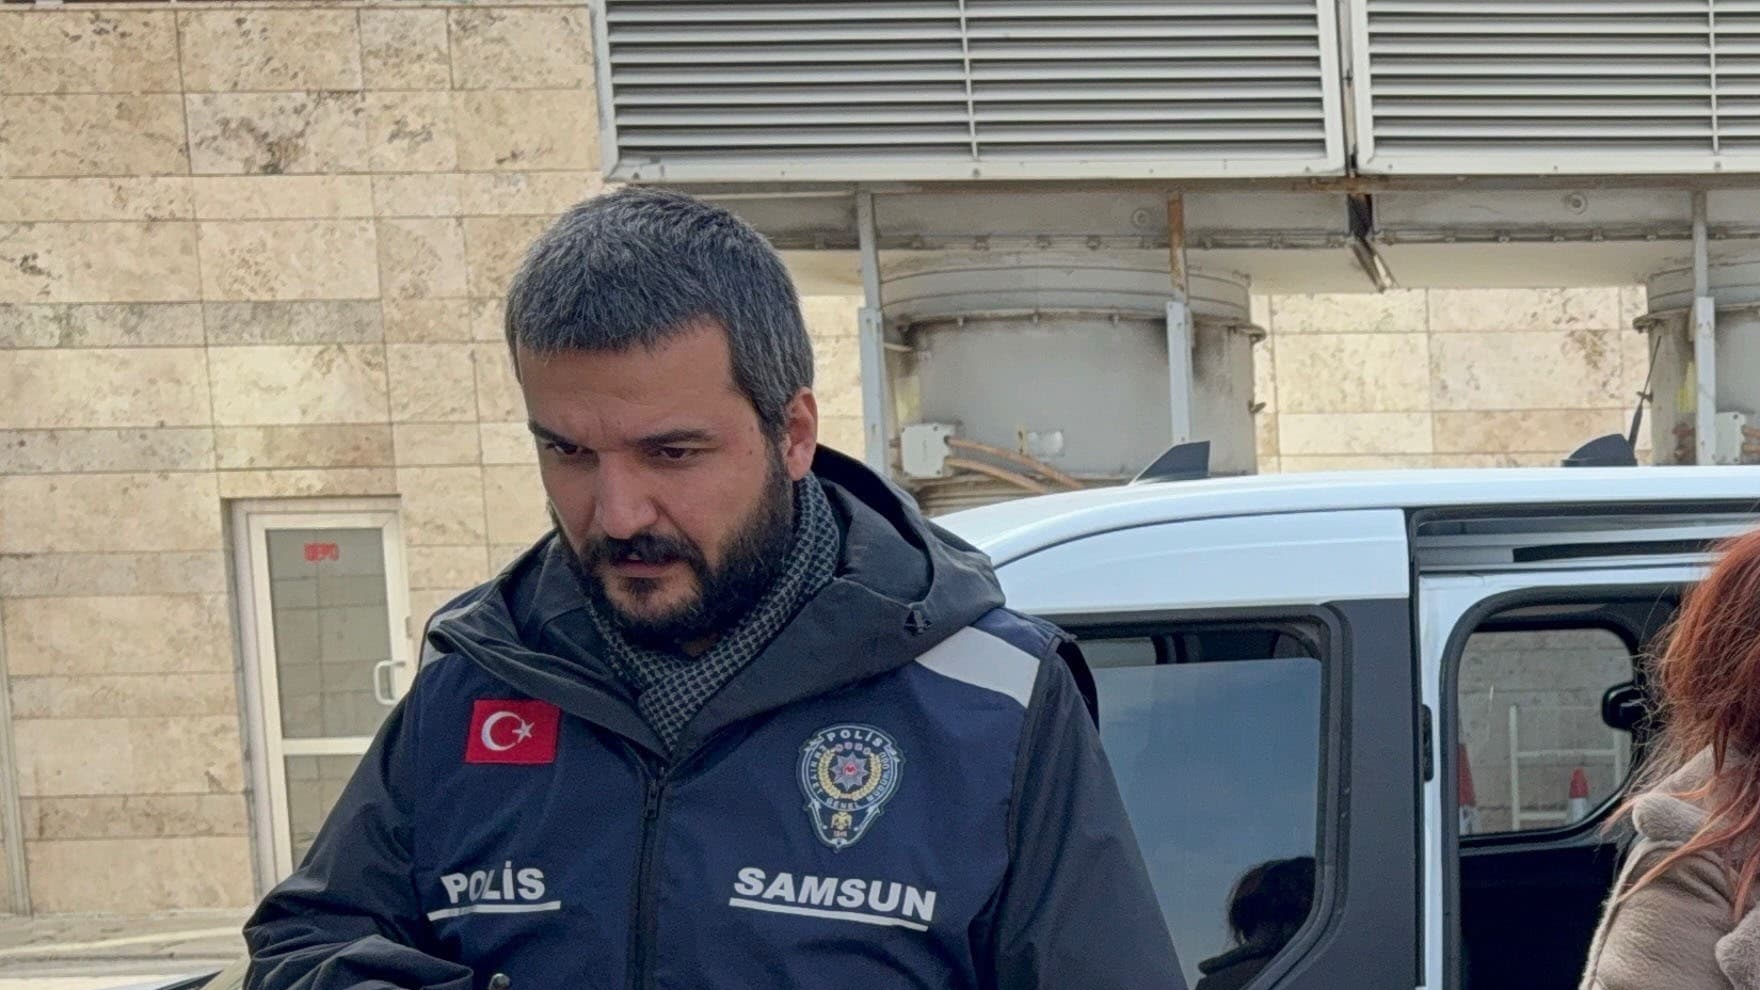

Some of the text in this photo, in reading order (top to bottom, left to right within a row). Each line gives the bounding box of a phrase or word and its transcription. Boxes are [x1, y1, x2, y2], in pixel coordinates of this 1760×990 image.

[827, 730, 883, 747] POLİS
[441, 860, 546, 904] POLİS
[734, 867, 937, 921] SAMSUN
